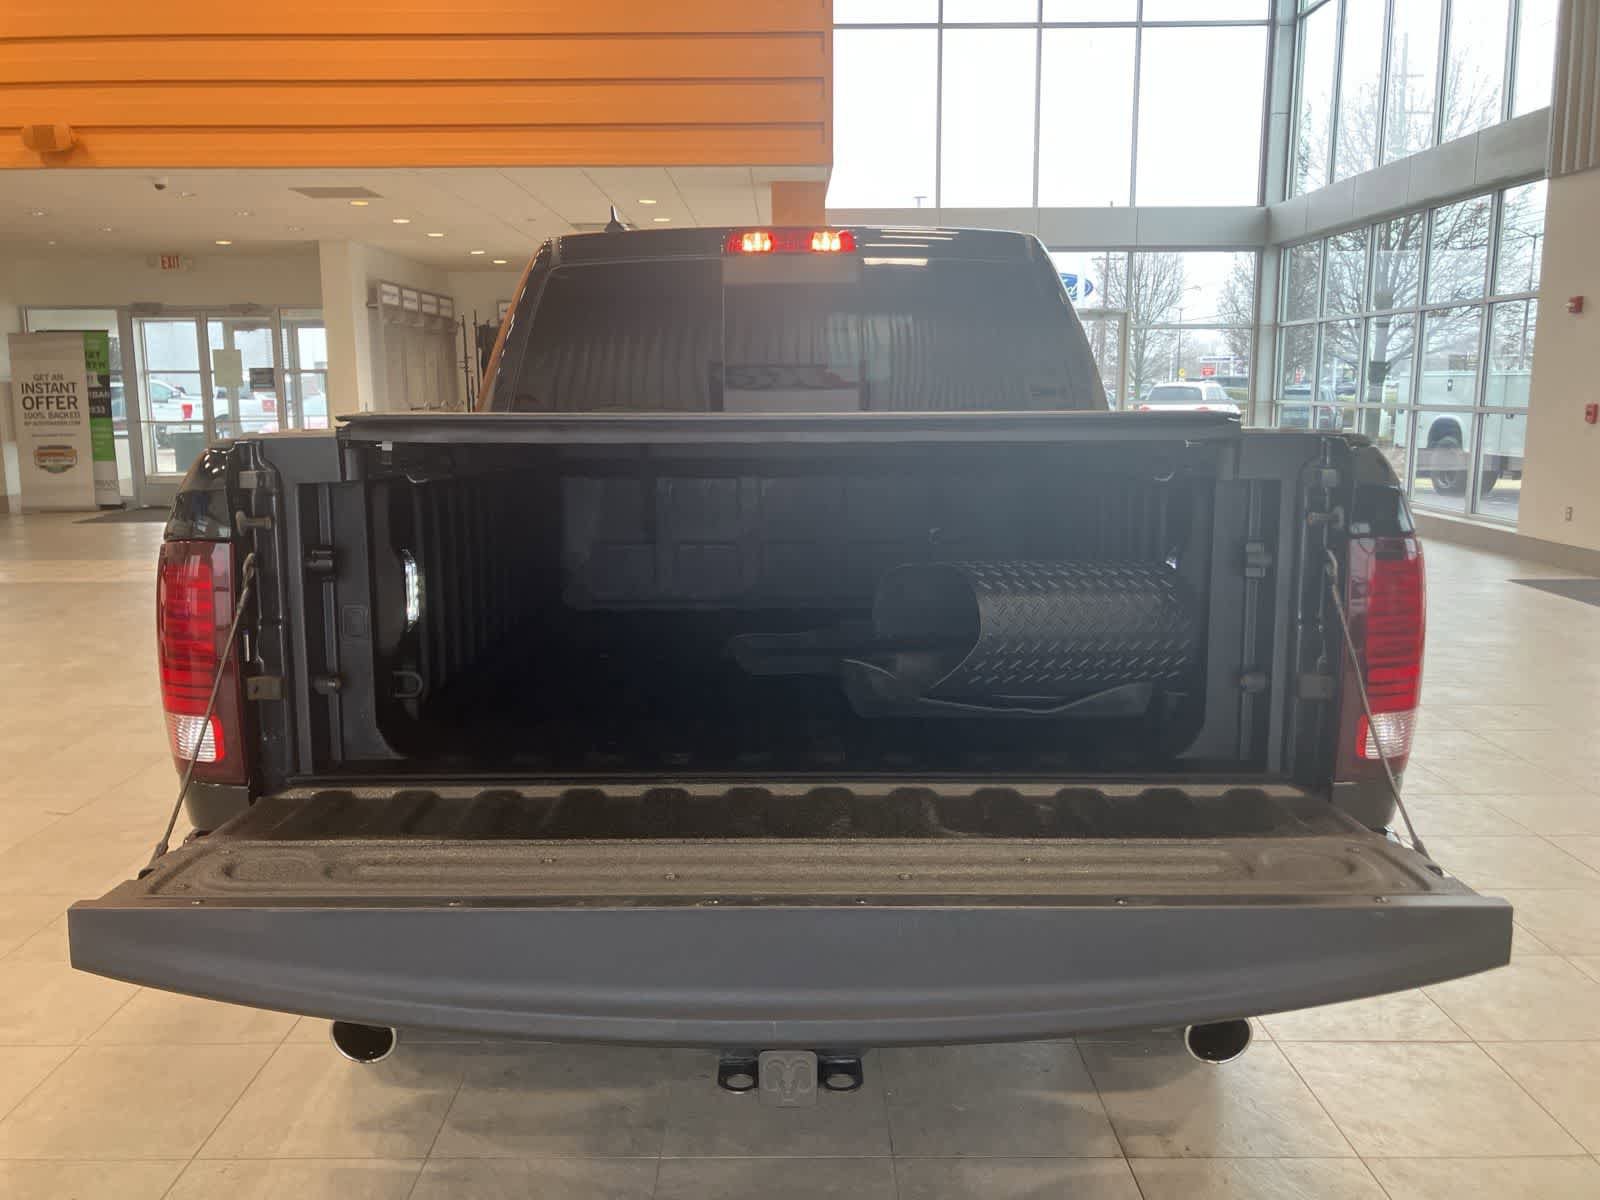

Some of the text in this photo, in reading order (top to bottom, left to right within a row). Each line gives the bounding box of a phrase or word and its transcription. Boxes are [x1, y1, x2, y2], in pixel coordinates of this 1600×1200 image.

[161, 255, 180, 270] EXIT
[21, 382, 78, 394] INSTANT
[22, 395, 78, 410] OFFER
